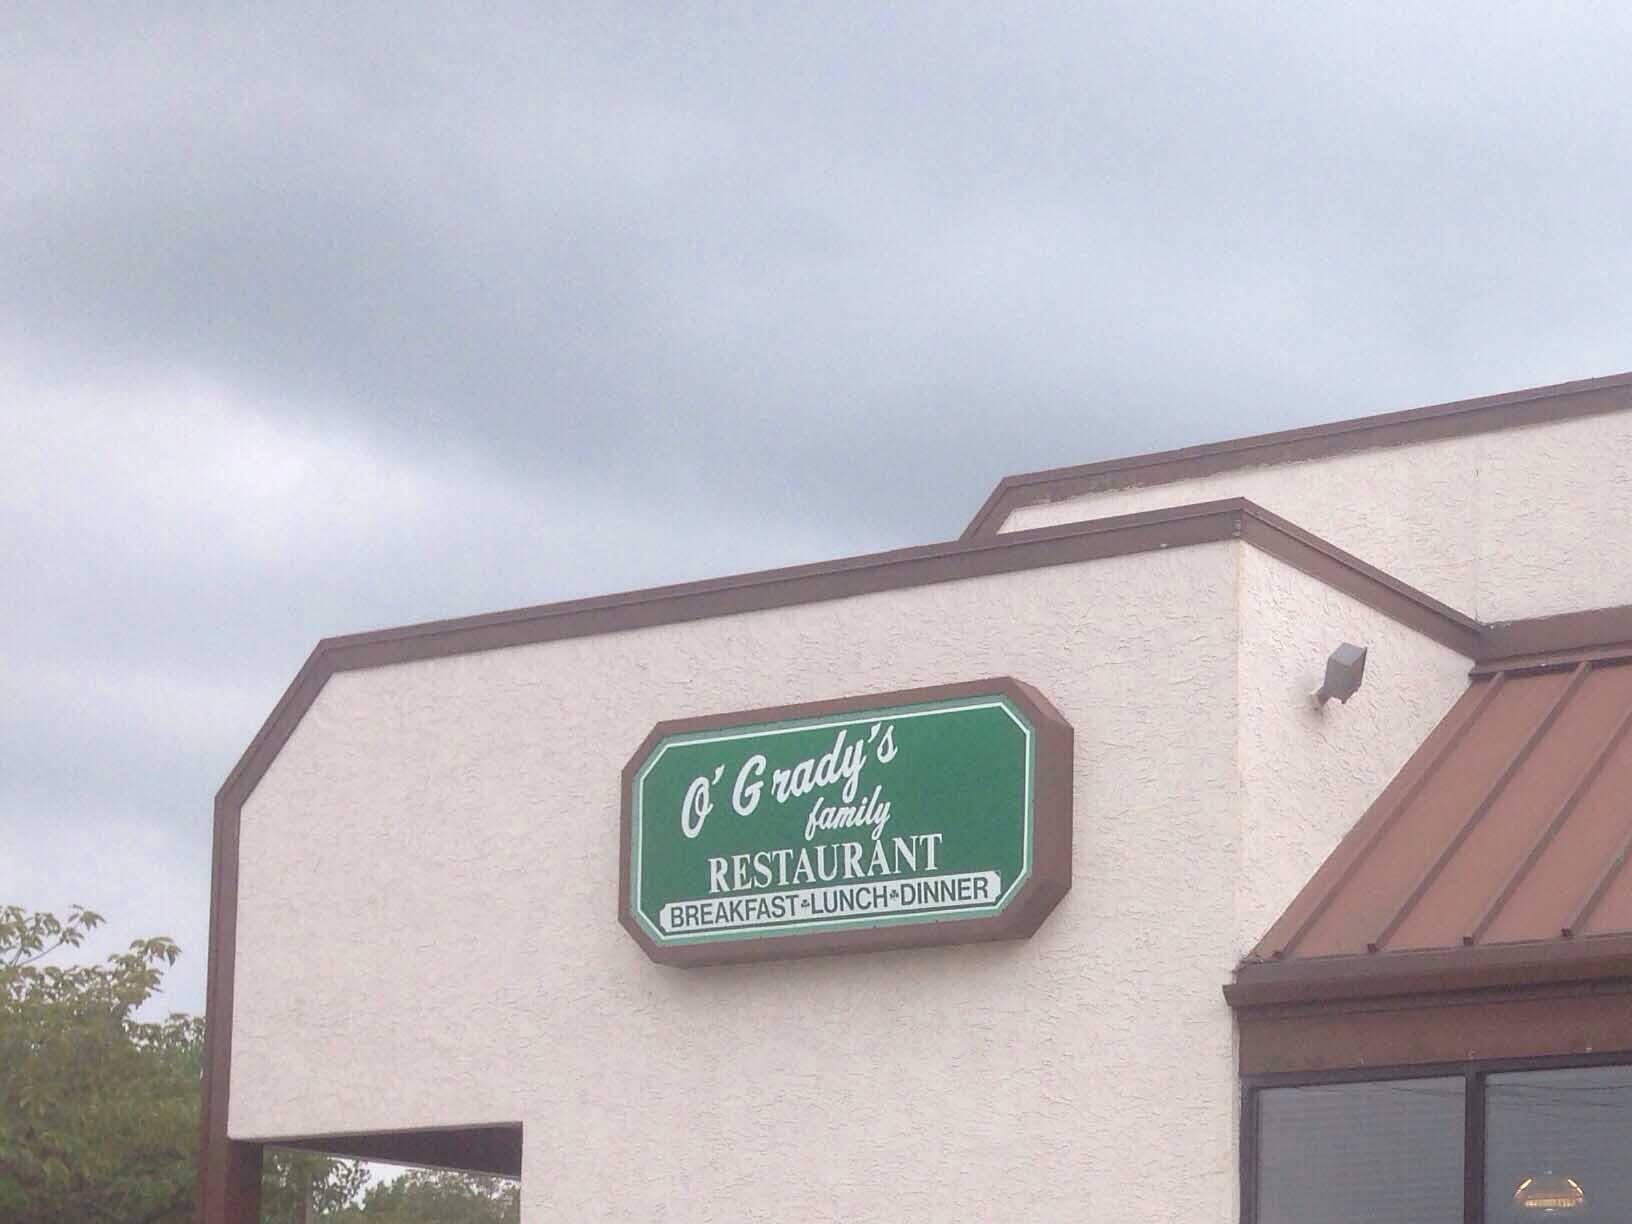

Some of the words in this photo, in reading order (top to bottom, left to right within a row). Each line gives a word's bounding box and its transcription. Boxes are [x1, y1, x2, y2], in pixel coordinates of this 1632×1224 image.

[804, 785, 891, 841] family
[707, 833, 943, 894] RESTAURANT
[670, 894, 799, 928] BREAKFAST
[811, 885, 888, 914] LUNCH
[901, 876, 989, 906] DINNER
